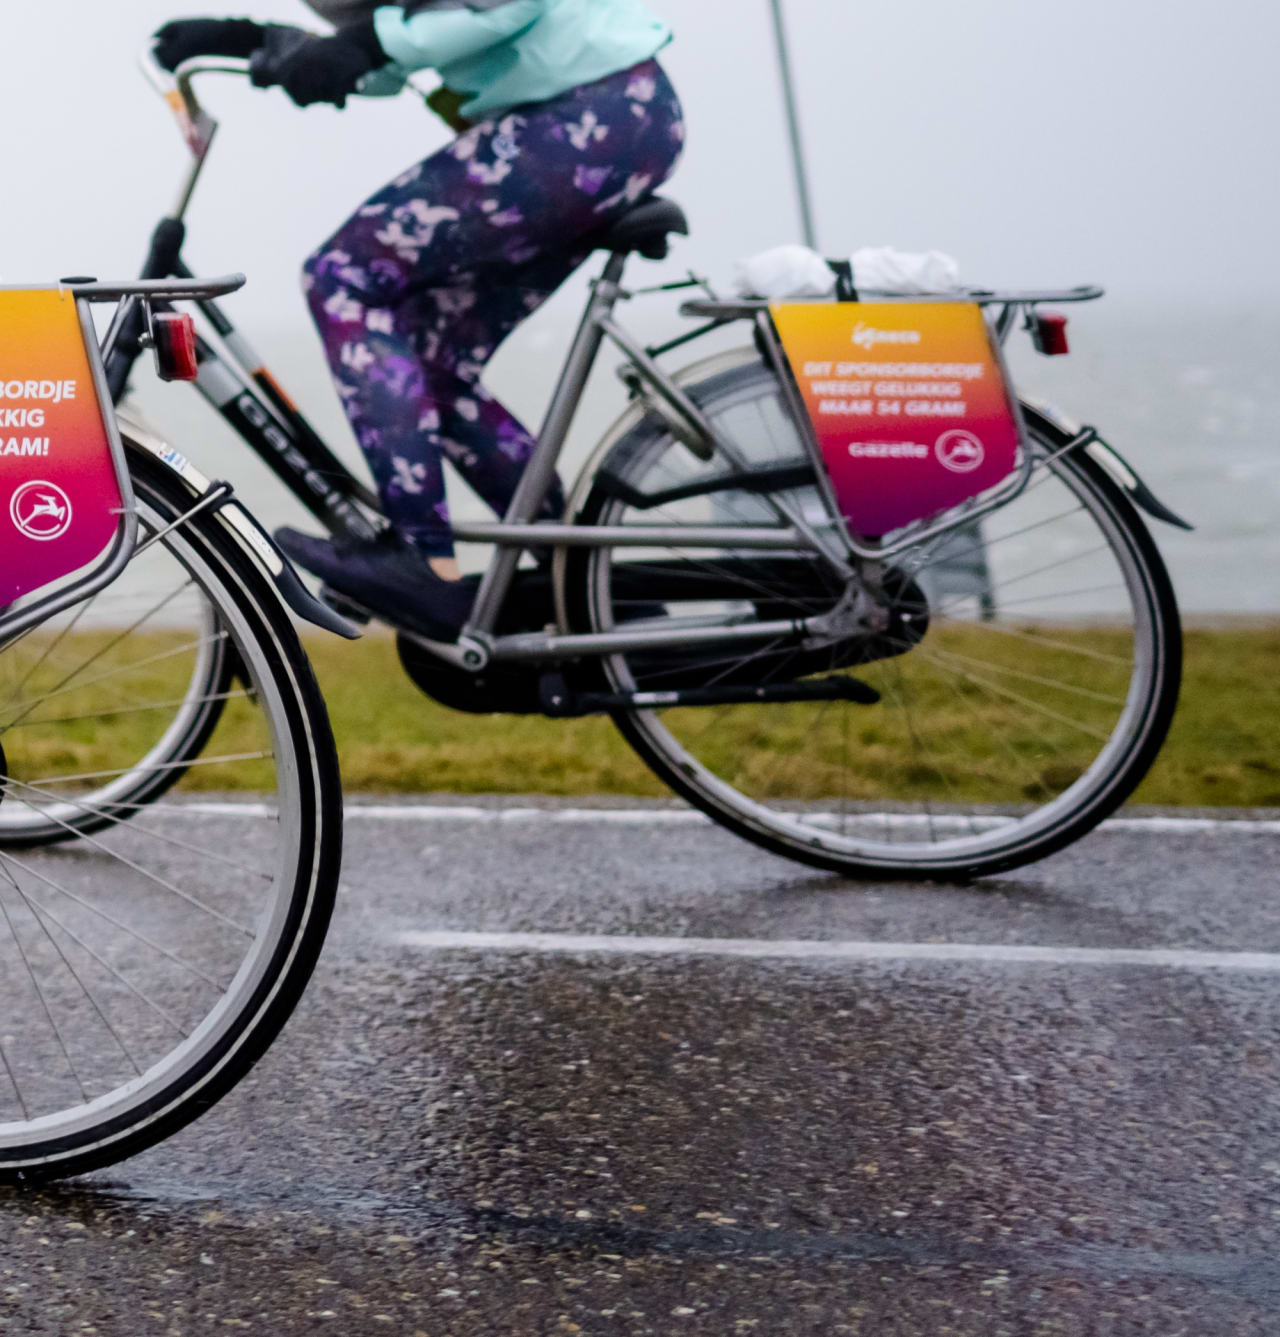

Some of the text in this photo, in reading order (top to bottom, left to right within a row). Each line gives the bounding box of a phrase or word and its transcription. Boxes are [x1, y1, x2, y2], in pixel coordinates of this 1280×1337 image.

[803, 362, 982, 380] DIT SPONSORBORDJE
[811, 381, 961, 397] WEEGT GELUKKIG
[818, 399, 873, 414] MAAR
[877, 400, 901, 415] 54
